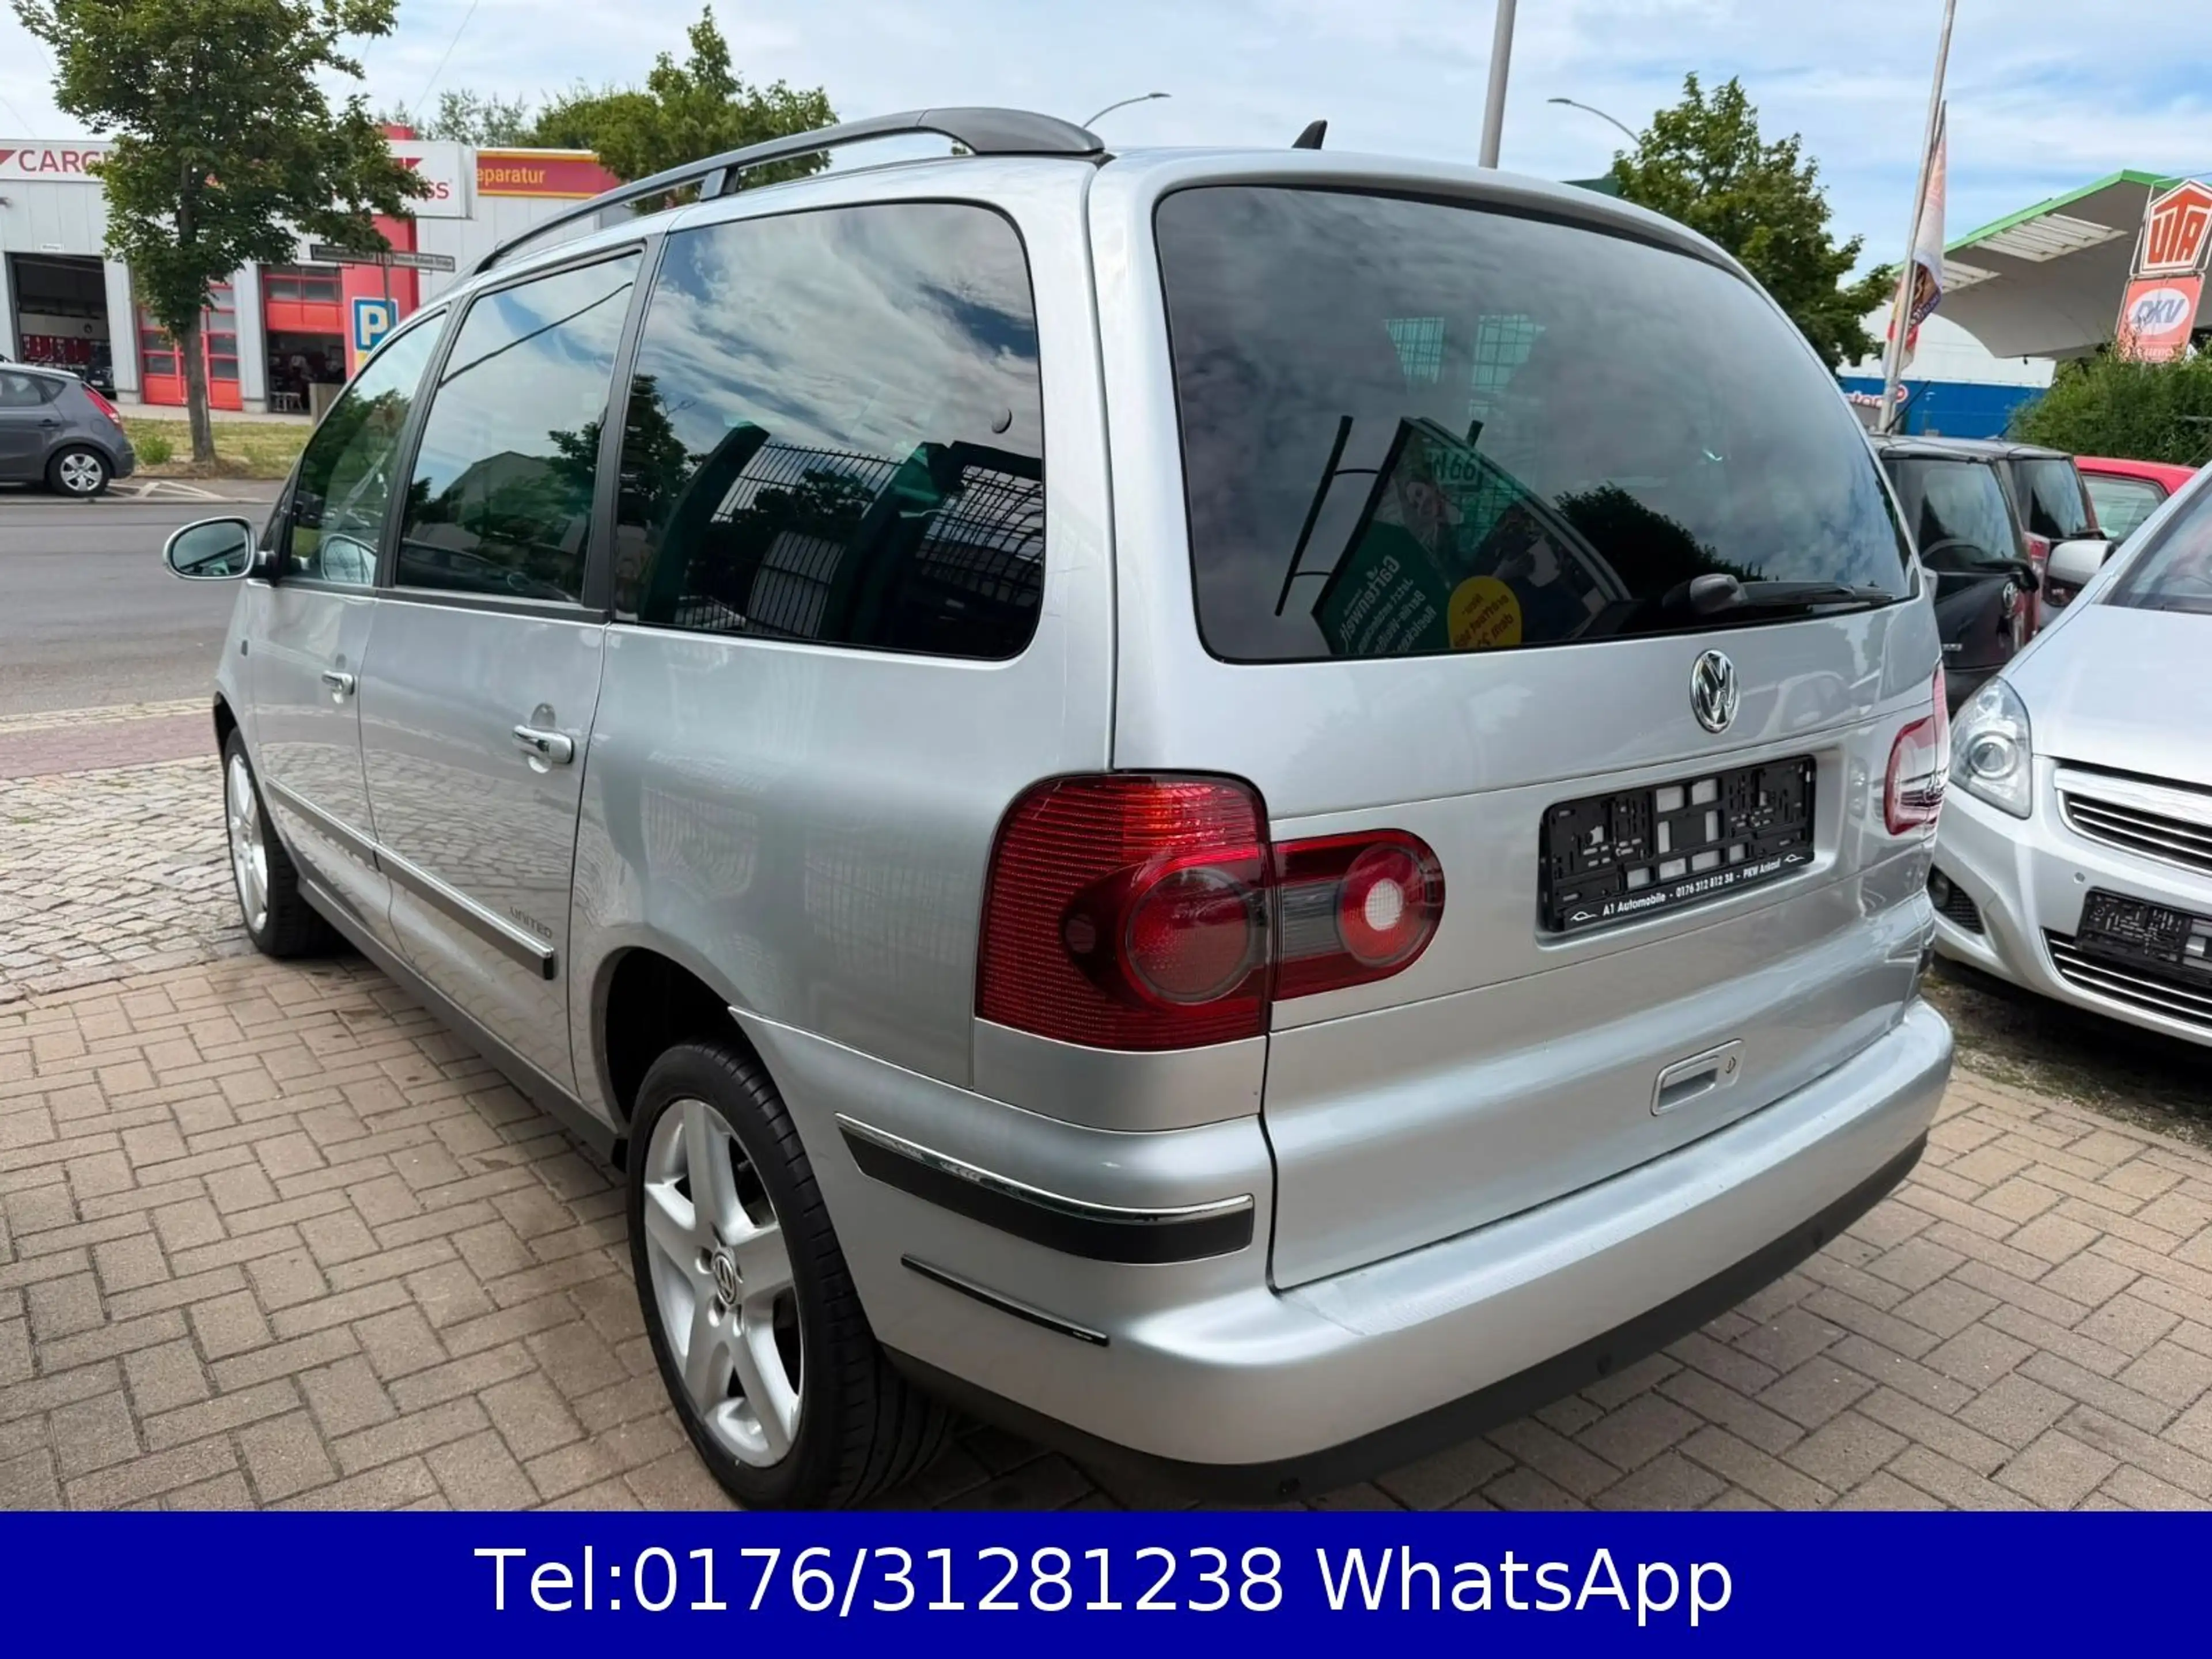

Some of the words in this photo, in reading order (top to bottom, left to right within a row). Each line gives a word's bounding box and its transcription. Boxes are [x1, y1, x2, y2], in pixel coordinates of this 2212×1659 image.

[359, 304, 388, 346] P
[2133, 298, 2186, 324] DKV
[1603, 903, 1615, 916] A1
[1618, 893, 1666, 913] Automobile
[1676, 882, 1694, 898] 0176
[1695, 879, 1709, 892] 312
[1743, 865, 1759, 879] PKW
